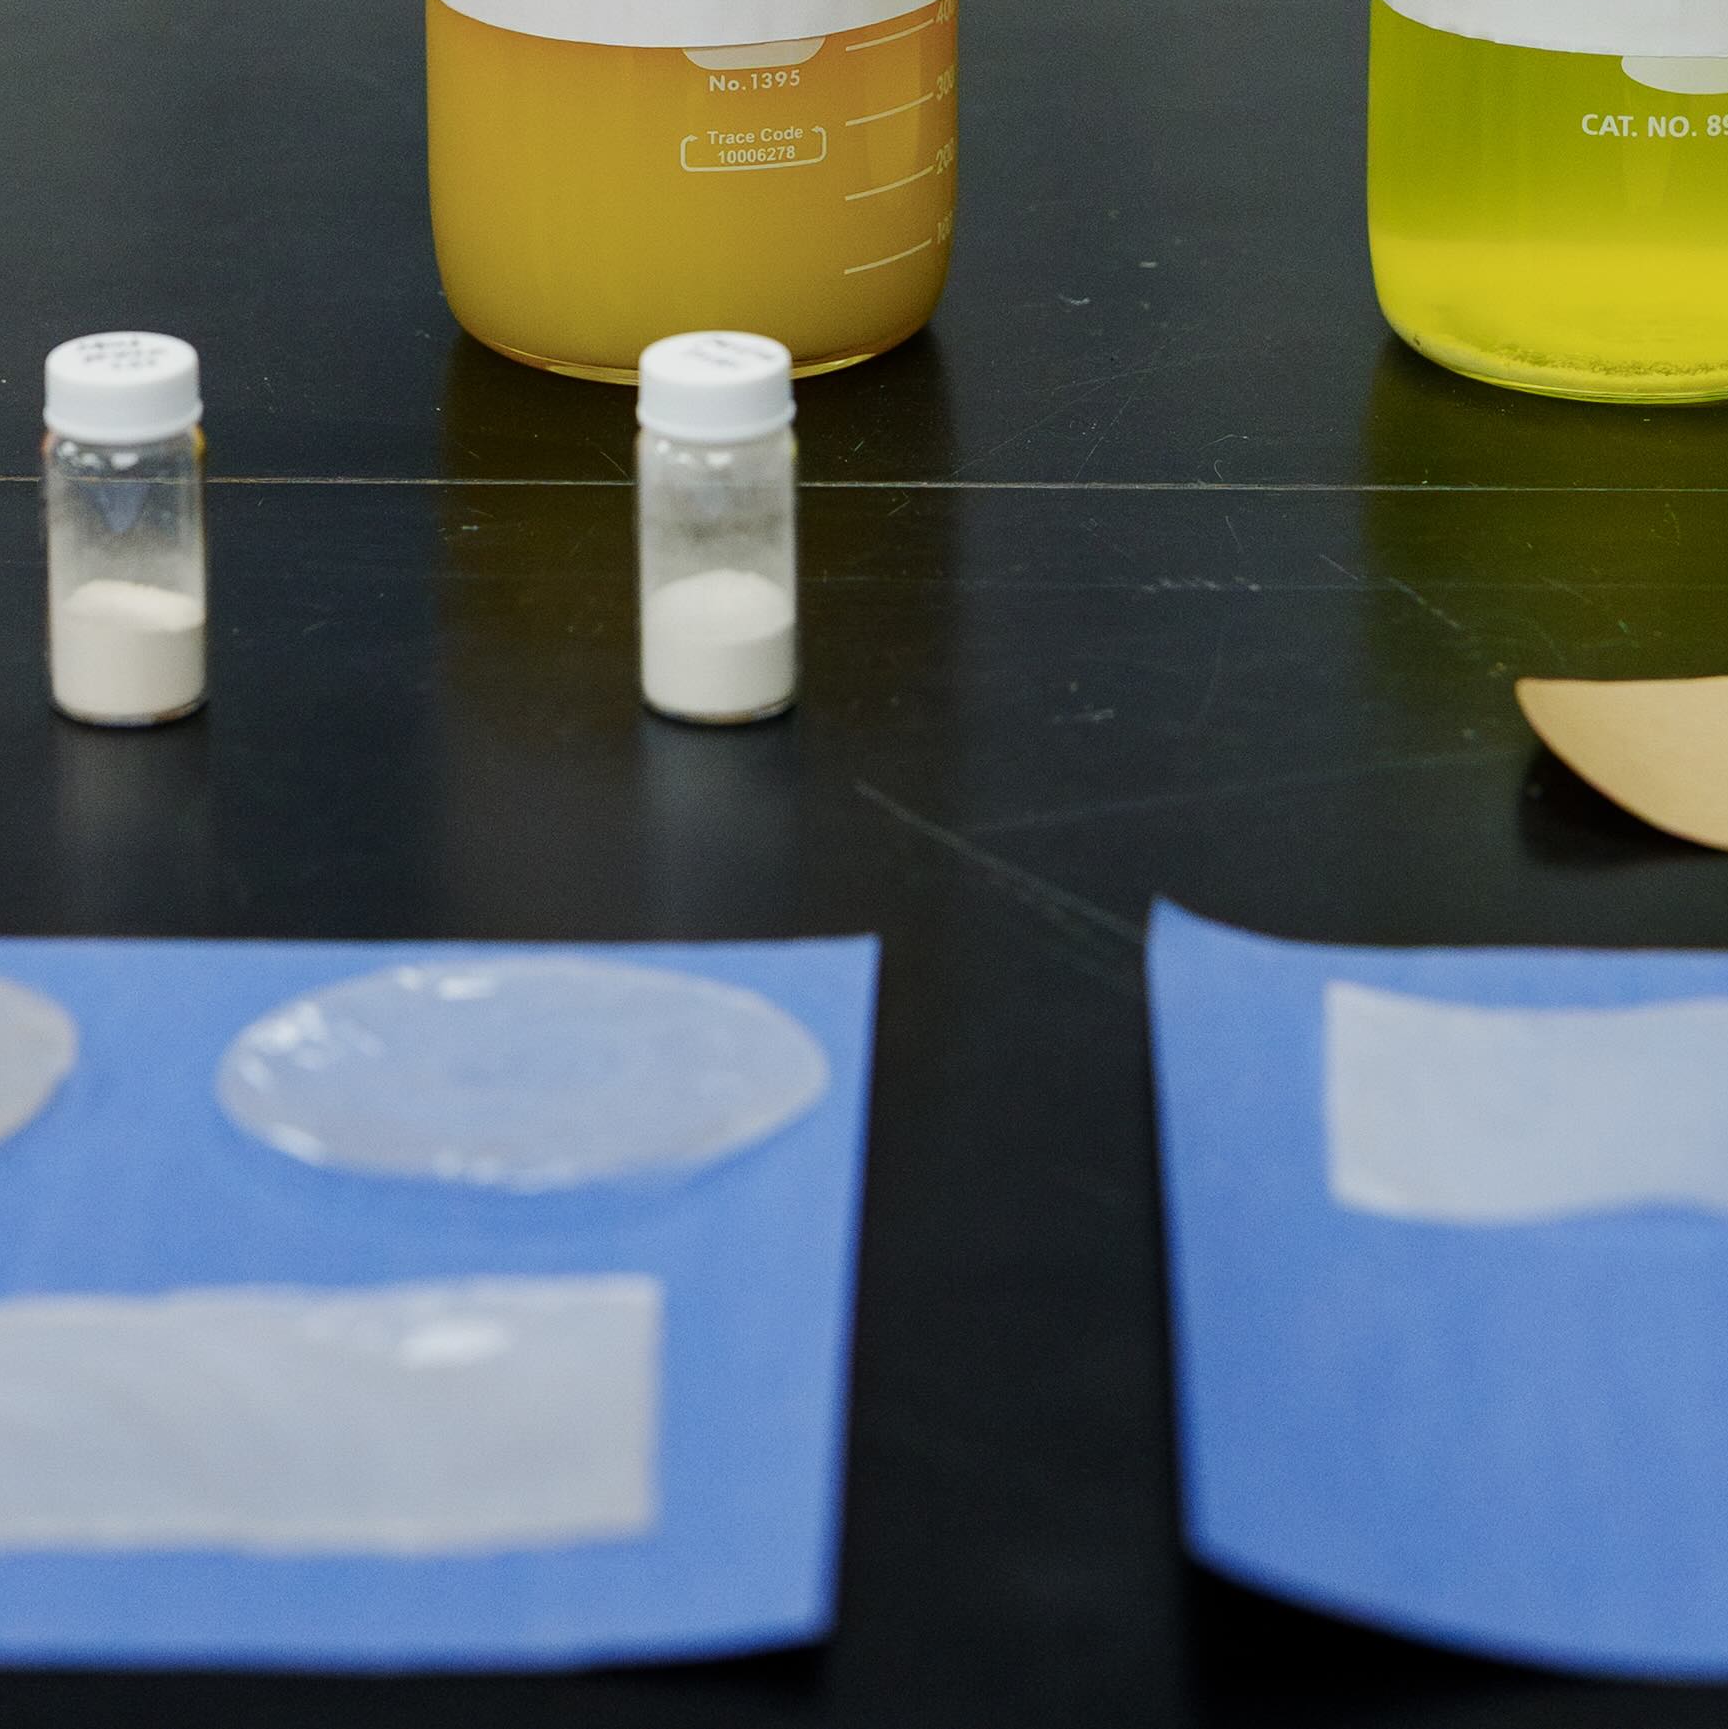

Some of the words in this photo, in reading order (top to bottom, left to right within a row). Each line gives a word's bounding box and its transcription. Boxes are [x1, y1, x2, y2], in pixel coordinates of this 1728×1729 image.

[1582, 113, 1638, 137] CAT.
[1648, 115, 1697, 138] NO.
[707, 130, 755, 145] Trace
[760, 126, 804, 142] Code
[718, 145, 796, 163] 10006278
